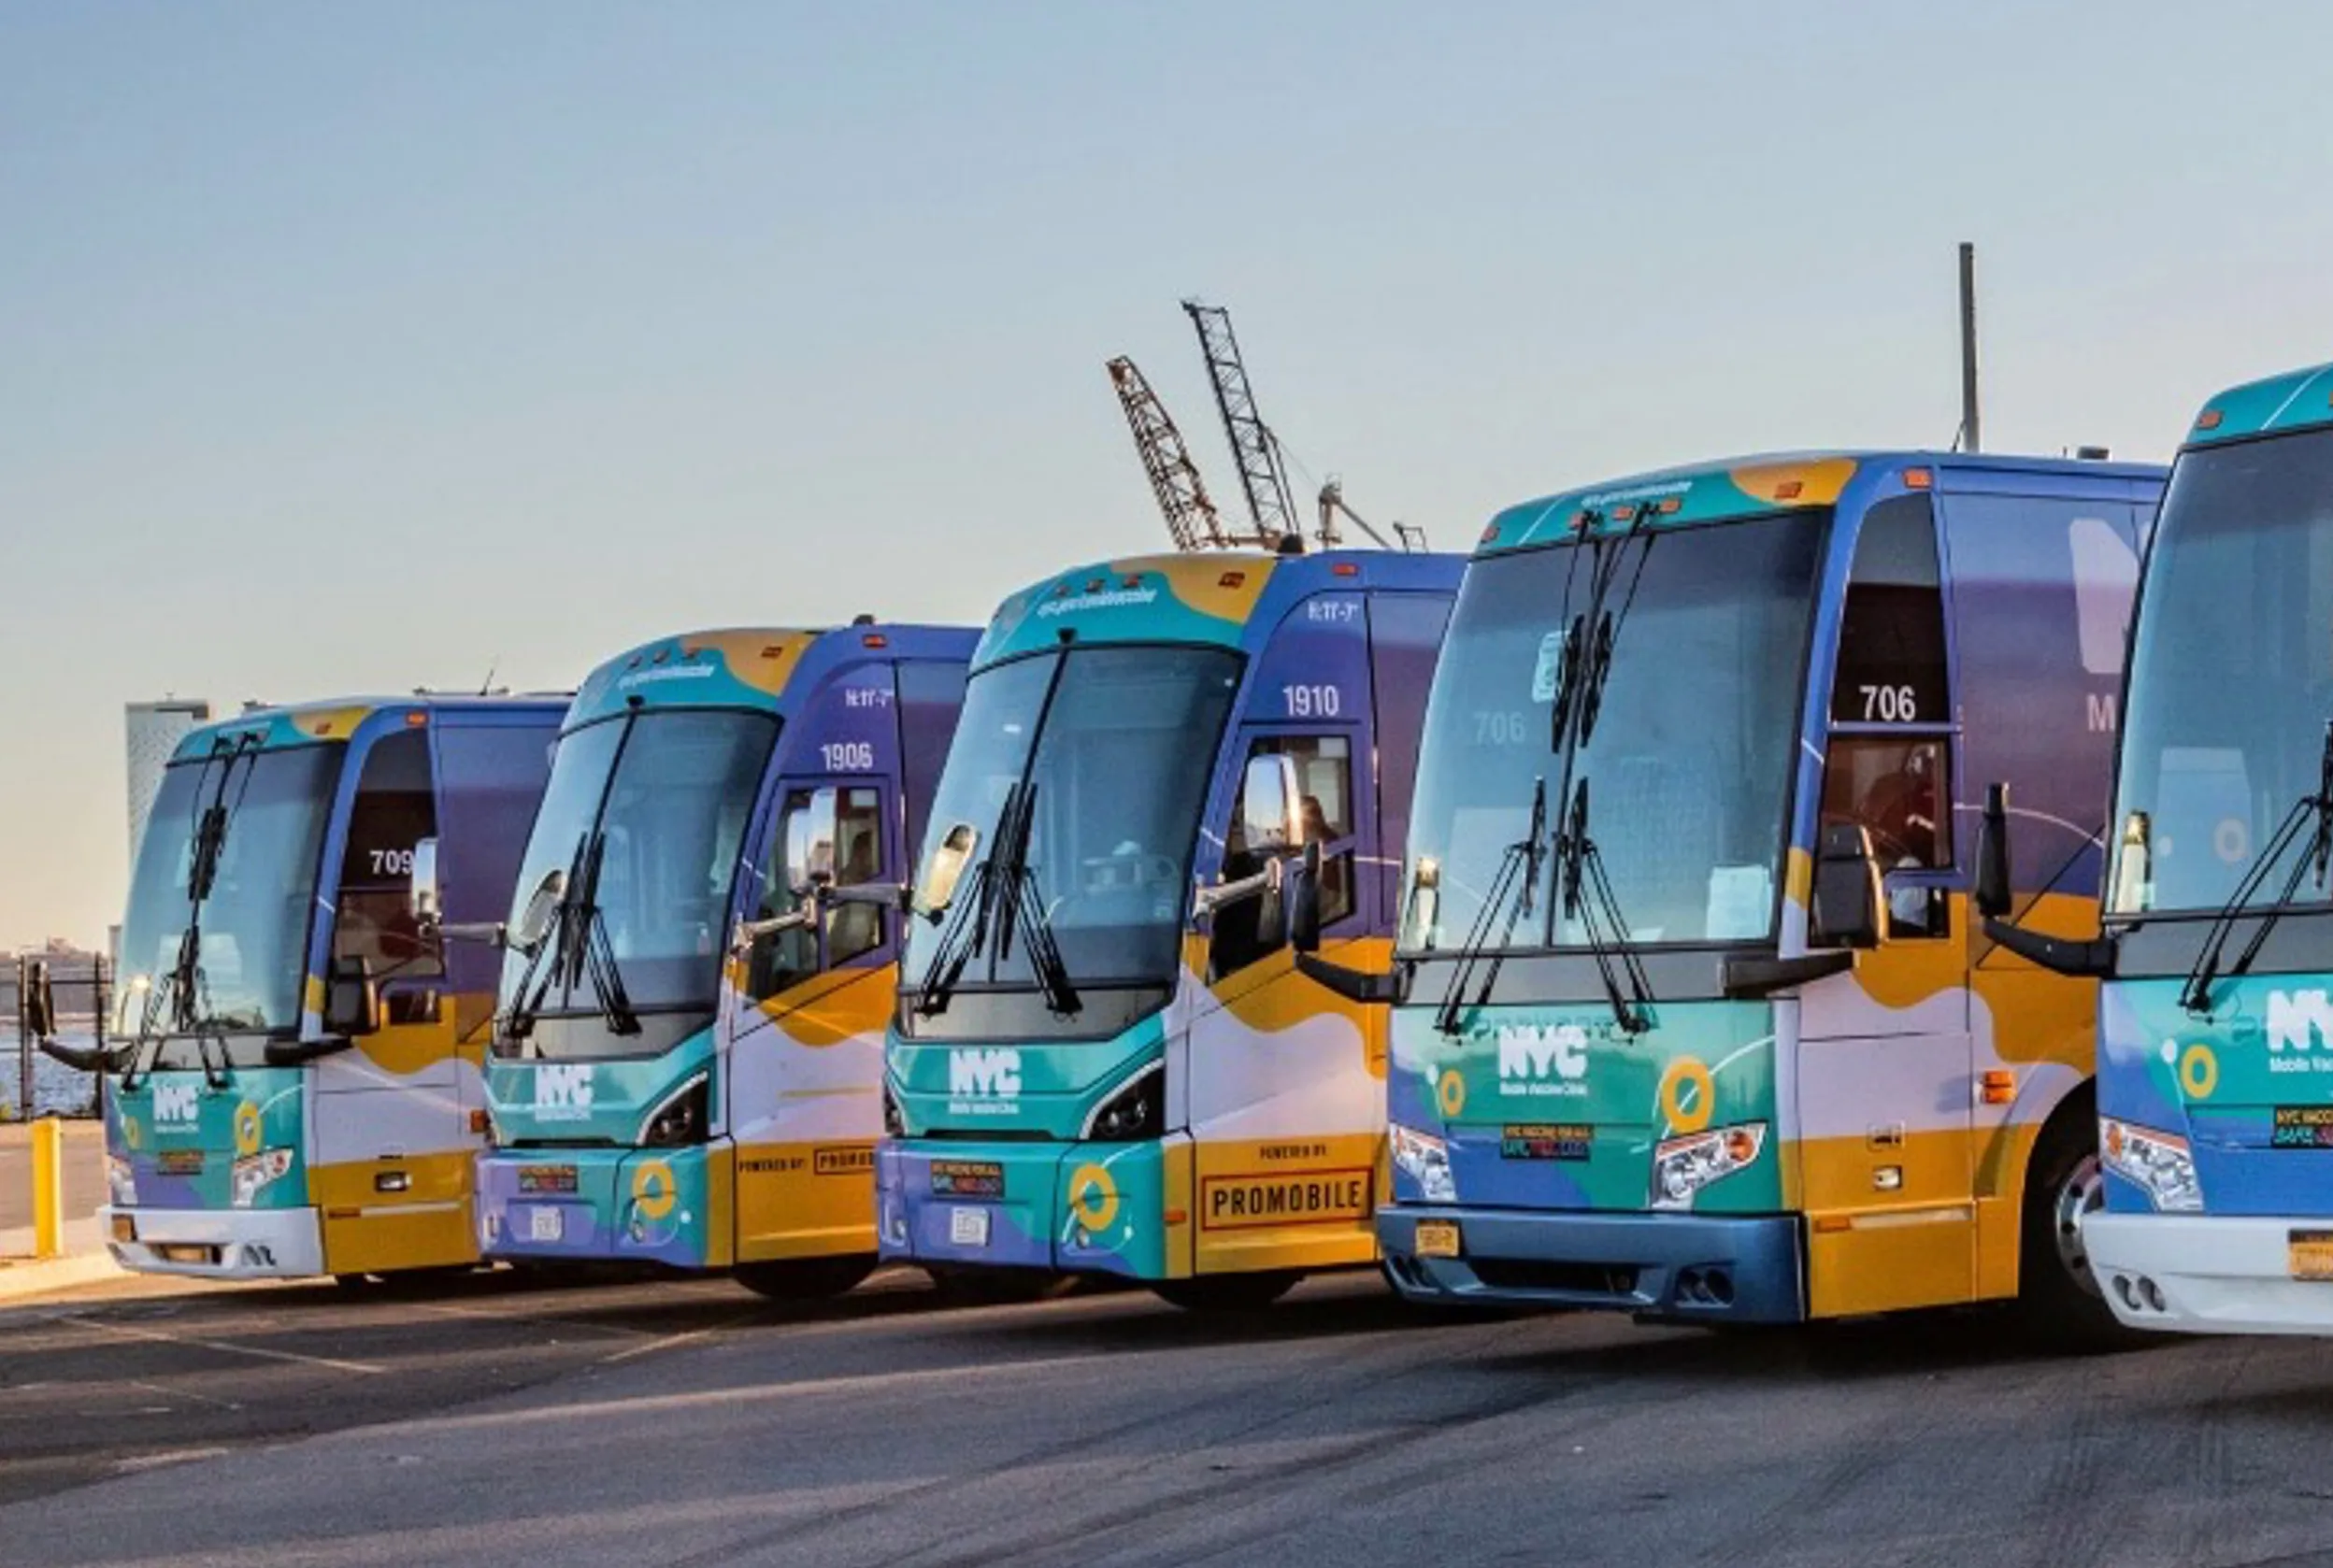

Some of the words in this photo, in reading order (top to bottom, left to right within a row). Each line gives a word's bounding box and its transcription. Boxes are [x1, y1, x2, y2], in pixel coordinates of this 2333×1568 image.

[1282, 684, 1339, 717] 1910
[1859, 684, 1916, 722] 706
[820, 741, 873, 771] 1906
[369, 849, 413, 875] 709
[1499, 1025, 1587, 1078] NYC
[535, 1063, 594, 1106] NYC
[950, 1048, 1022, 1098] NYC
[1214, 1180, 1362, 1217] PROMOBILE
